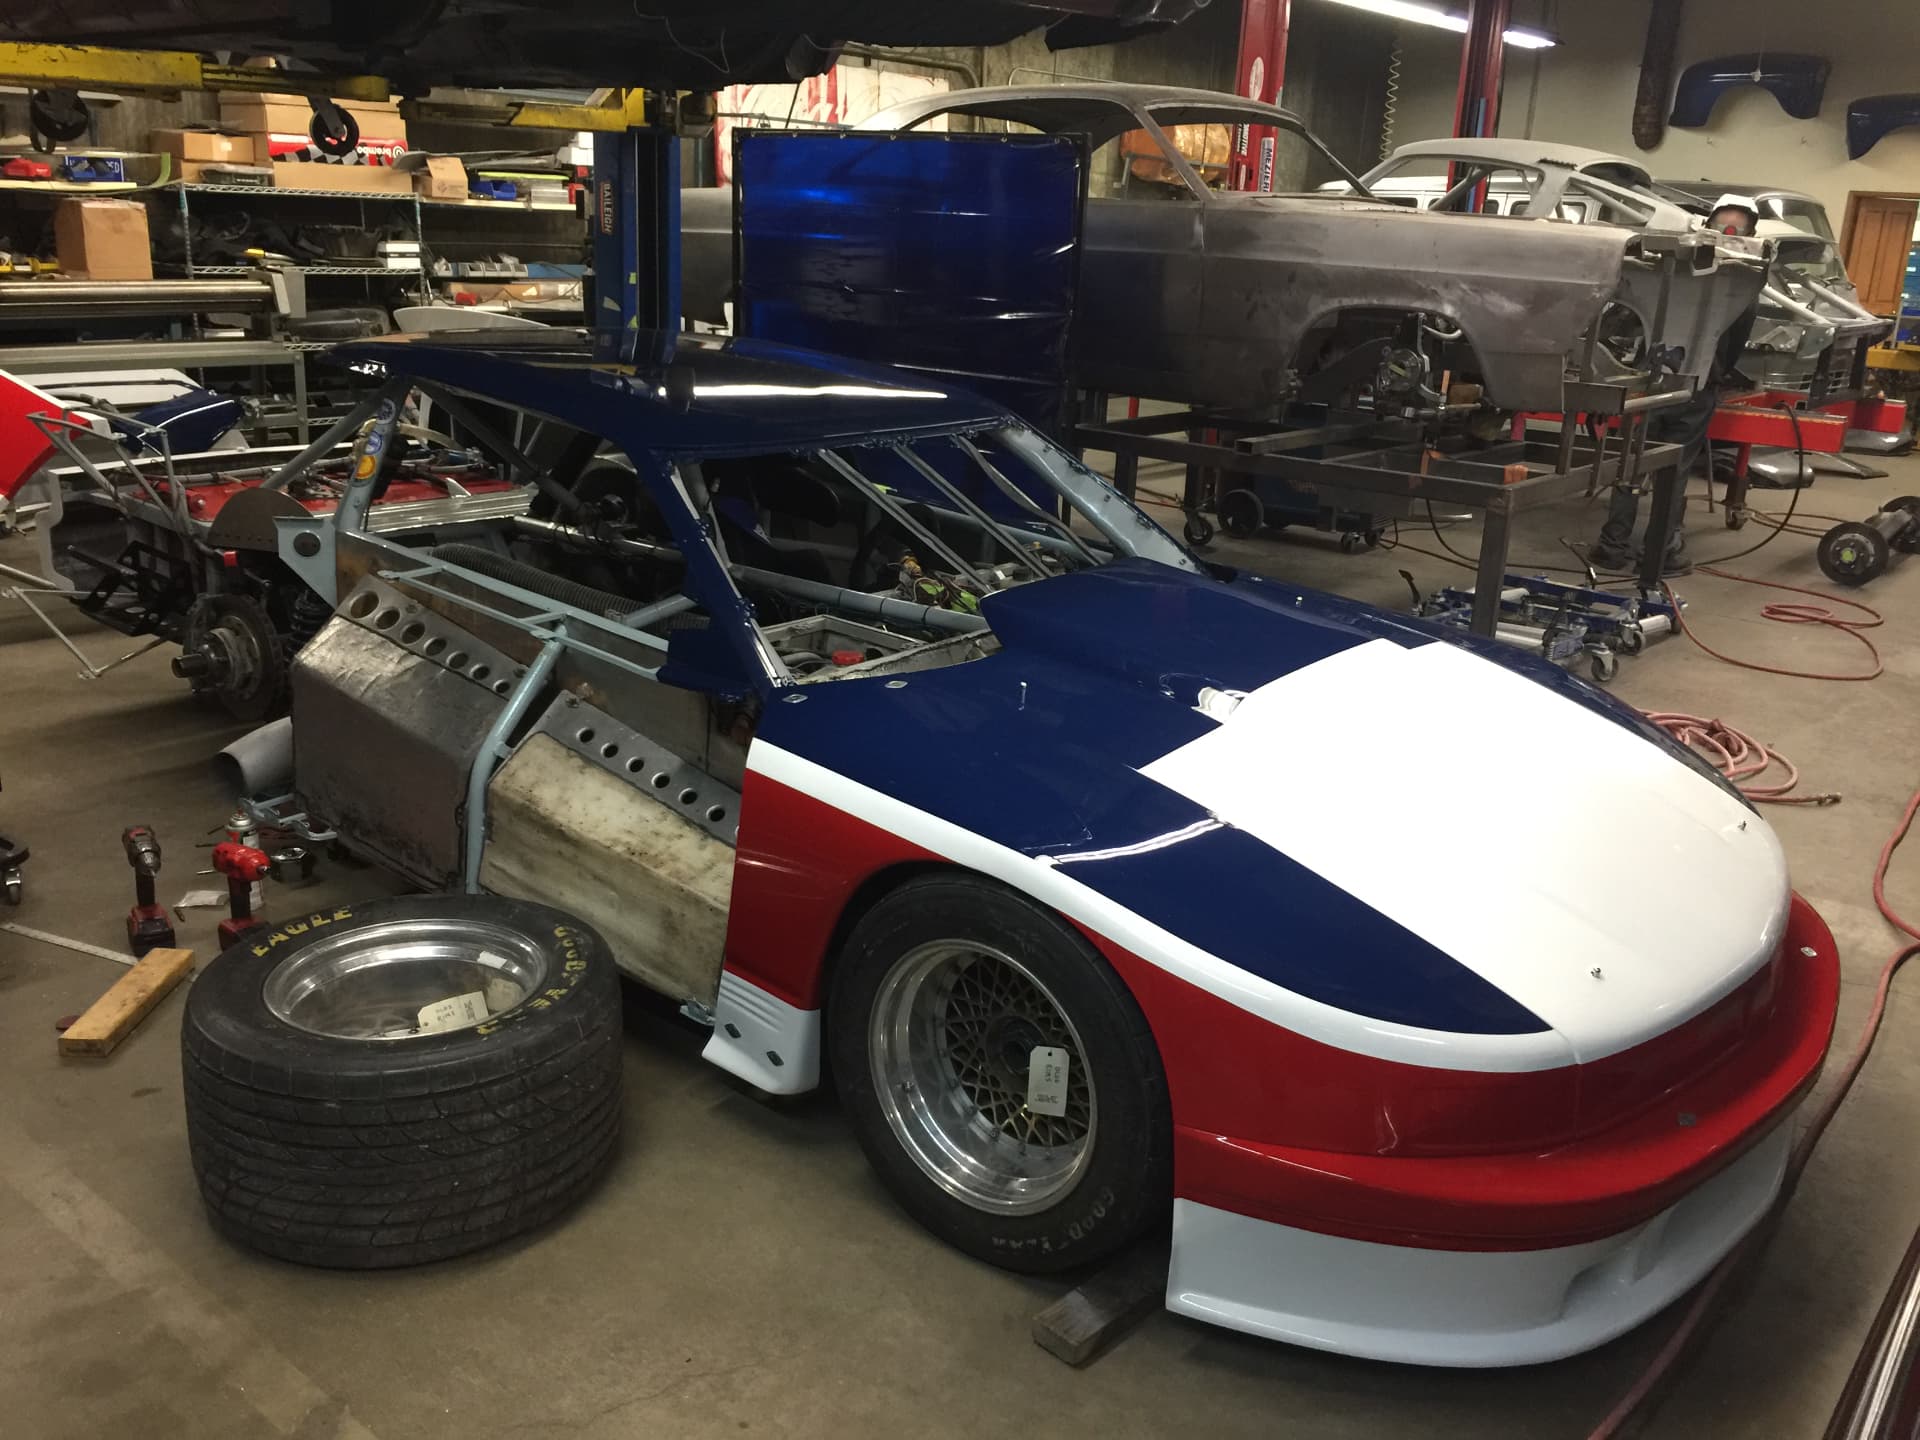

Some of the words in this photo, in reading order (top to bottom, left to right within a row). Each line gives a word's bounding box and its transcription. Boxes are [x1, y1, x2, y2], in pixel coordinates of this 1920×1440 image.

[356, 145, 393, 159] brembo
[603, 183, 614, 233] BAILEIGH
[251, 905, 352, 957] EAGLE
